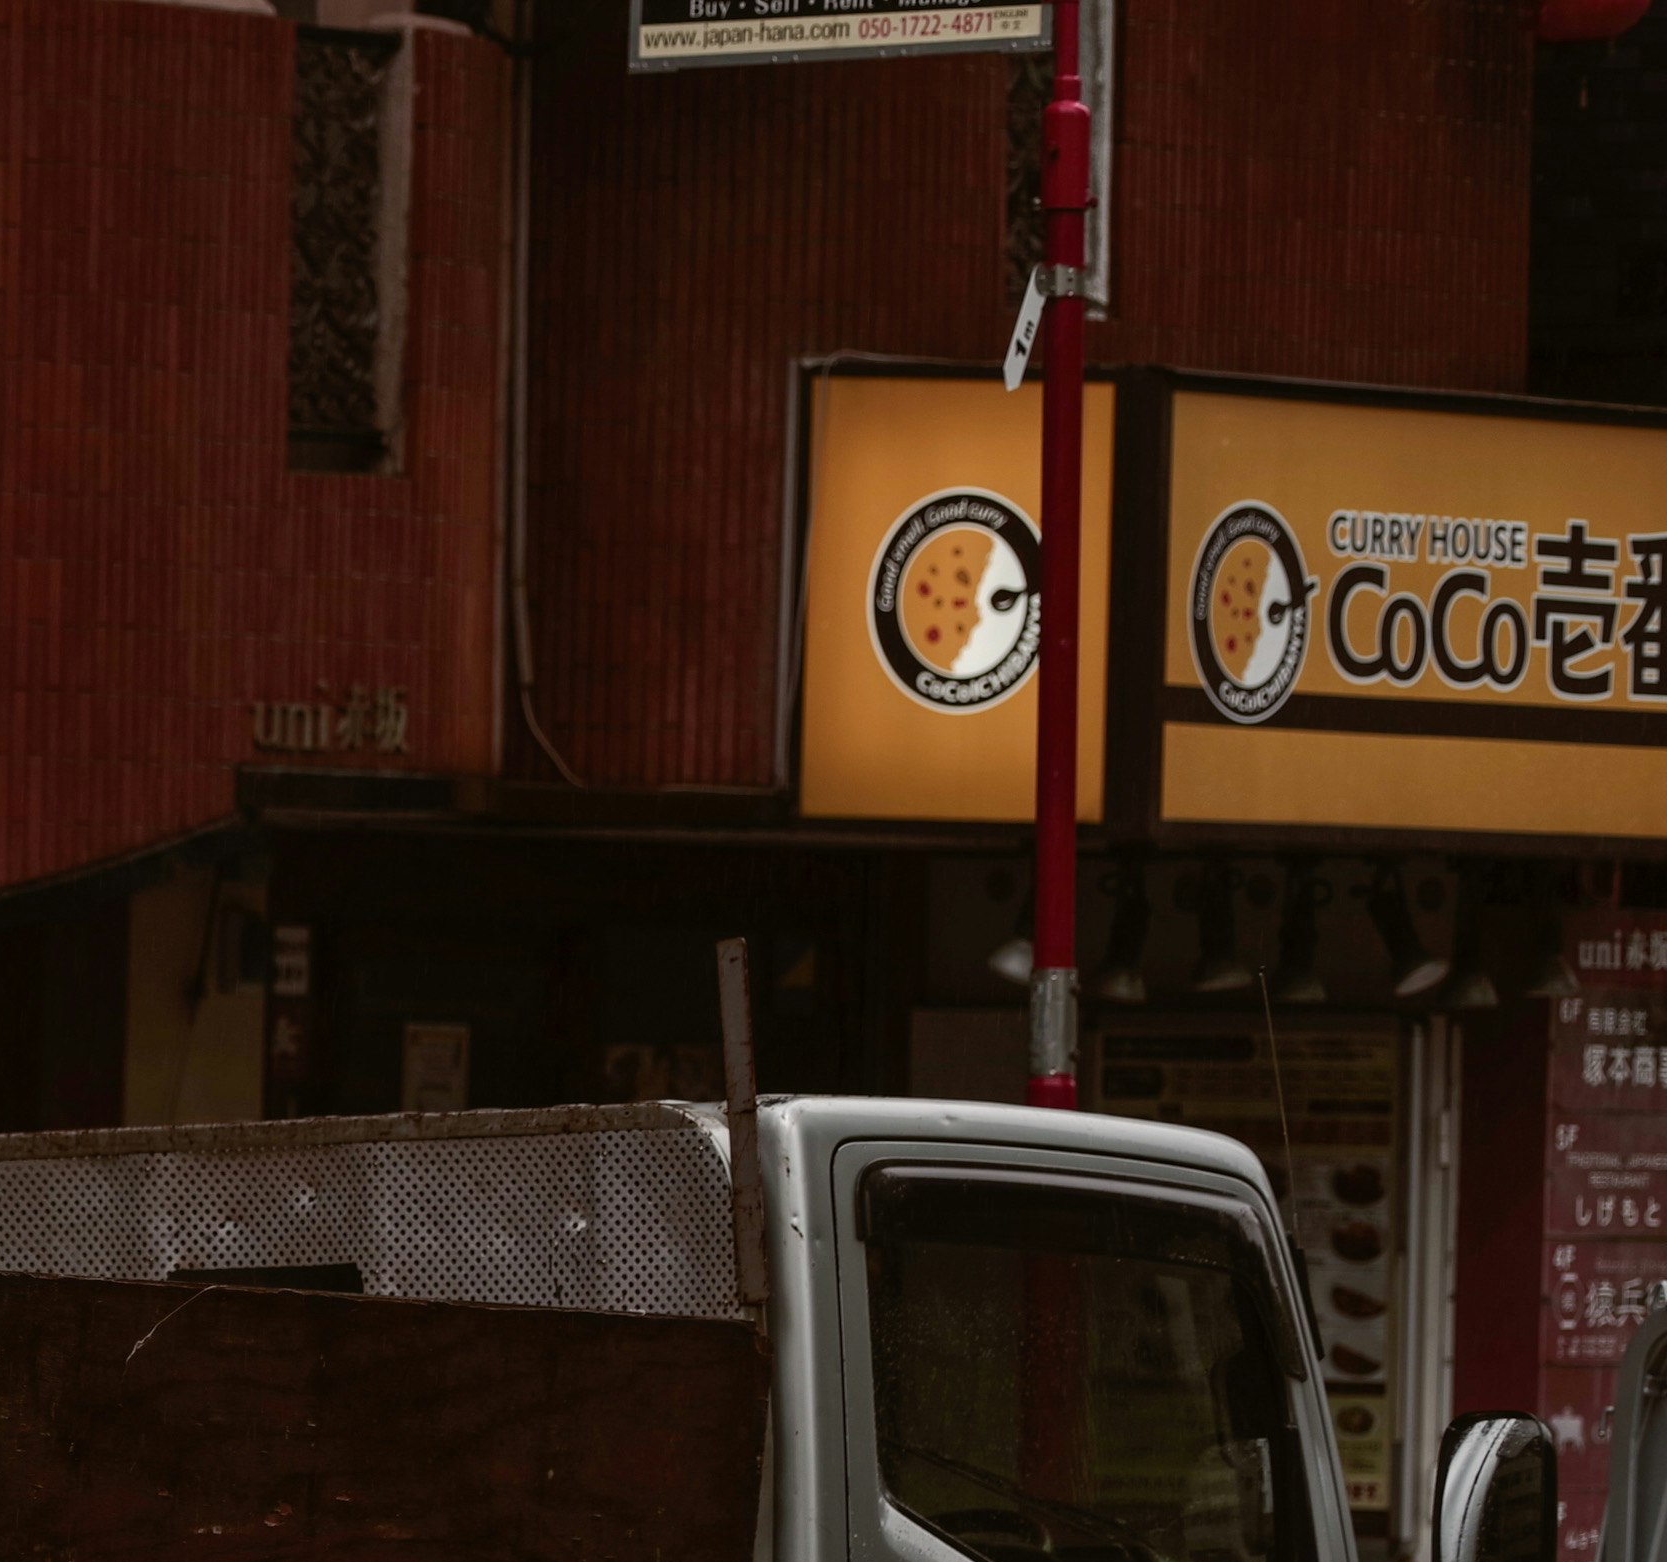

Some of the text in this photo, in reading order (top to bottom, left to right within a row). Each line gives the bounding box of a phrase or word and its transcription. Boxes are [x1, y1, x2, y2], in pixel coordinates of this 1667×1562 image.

[644, 20, 851, 49] www.japan-hana.com
[857, 12, 992, 40] 050-1722-4871
[1329, 511, 1527, 567] CURRY HOUSE
[1575, 1194, 1662, 1228] しげもと
